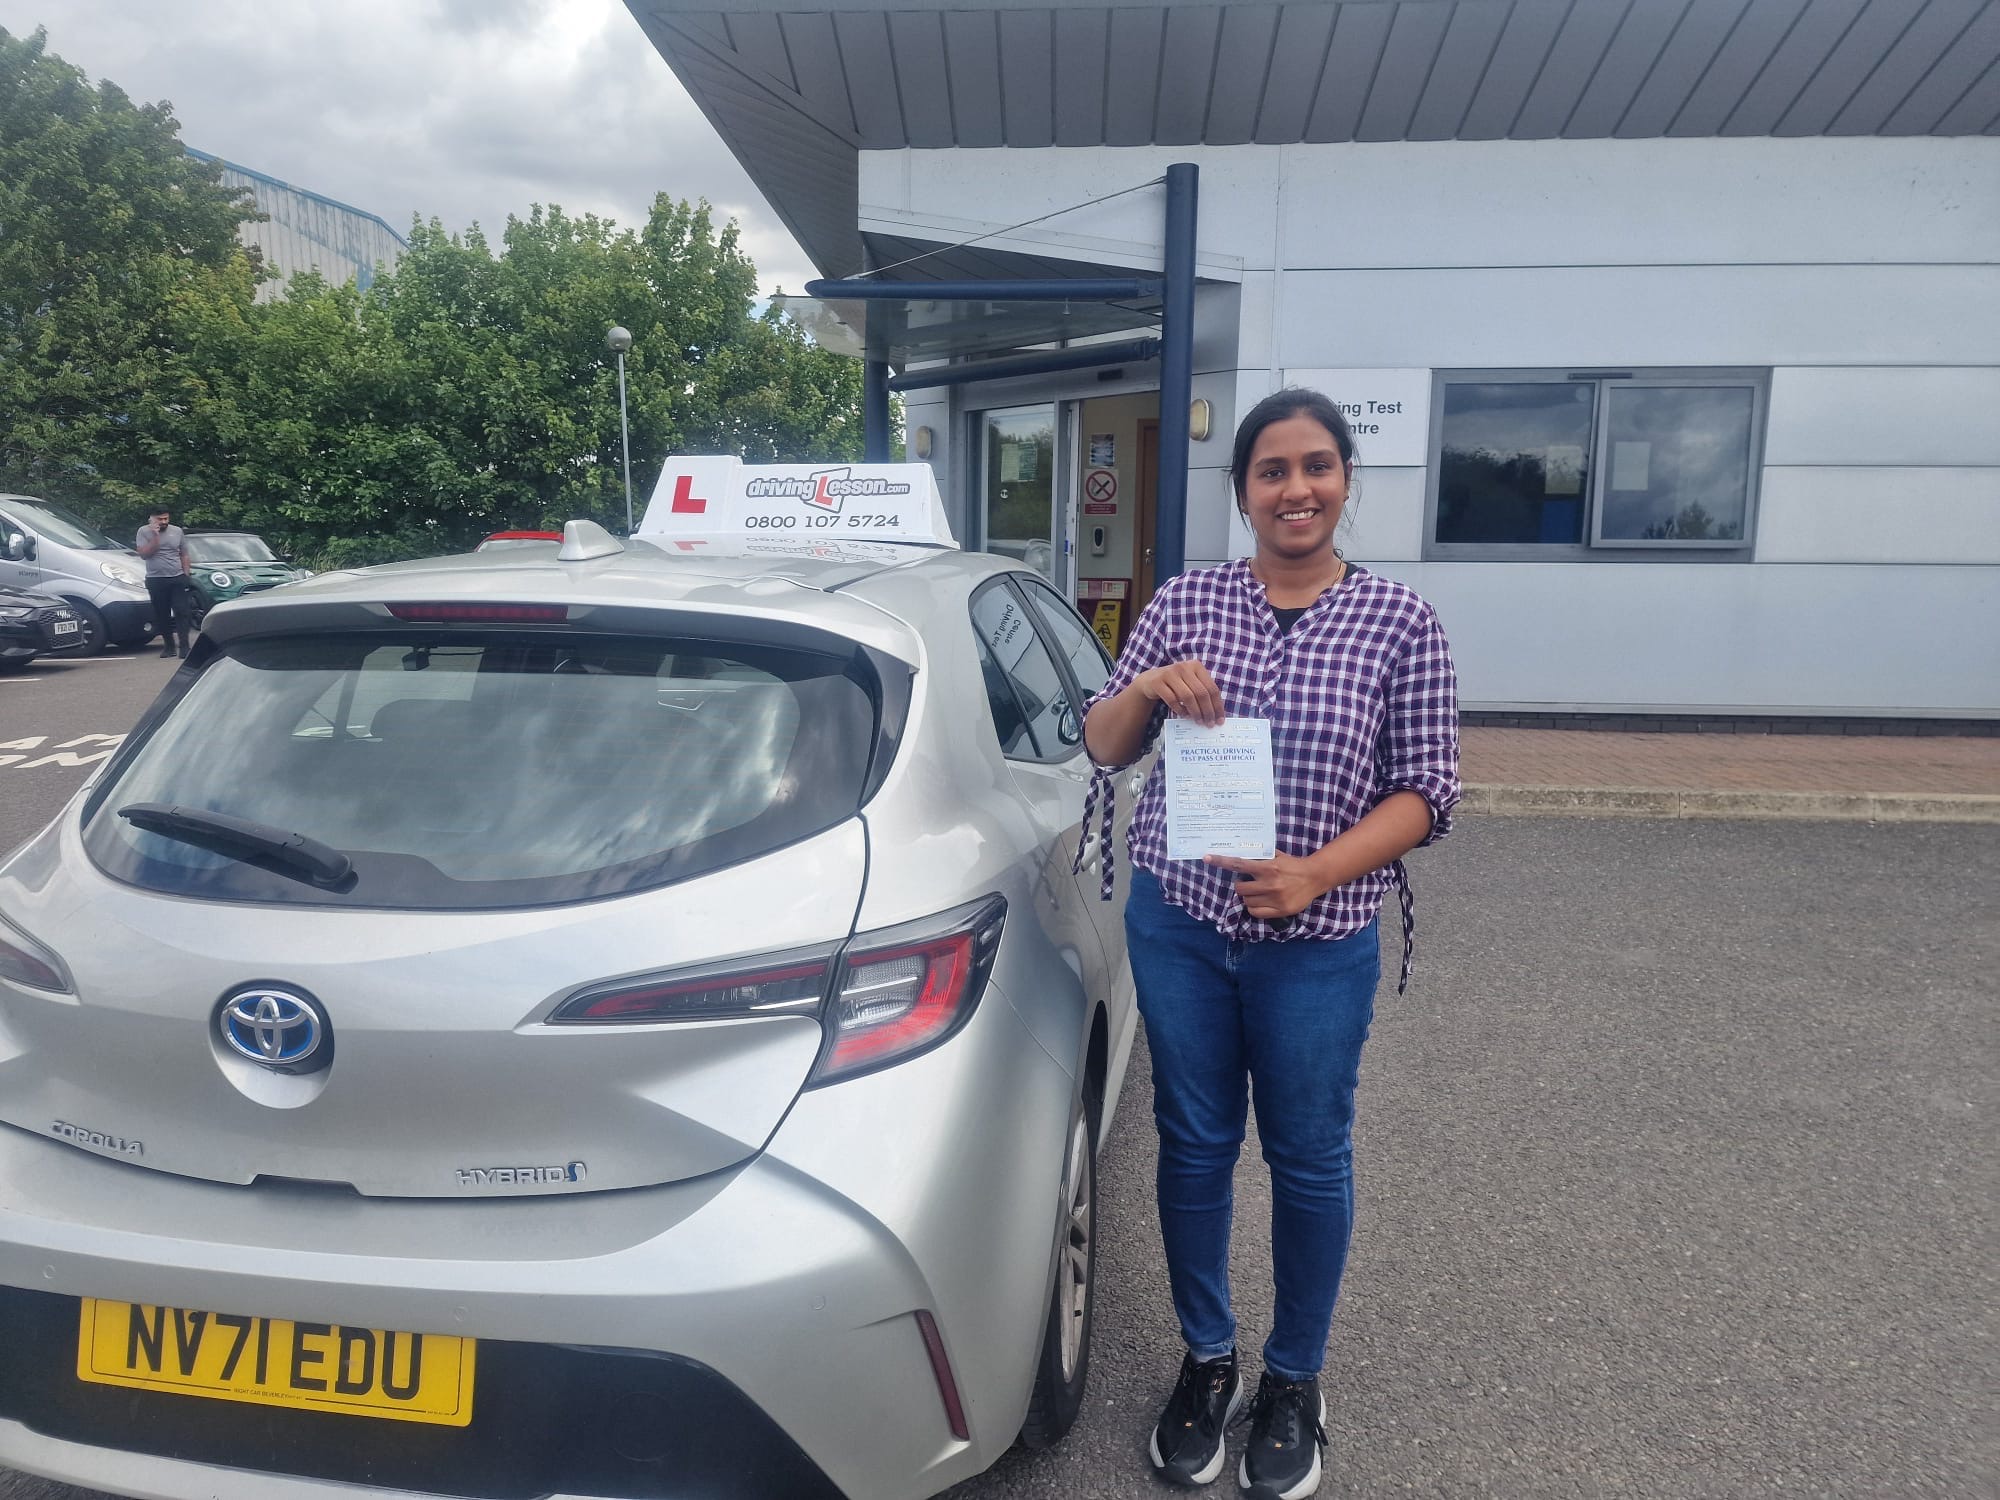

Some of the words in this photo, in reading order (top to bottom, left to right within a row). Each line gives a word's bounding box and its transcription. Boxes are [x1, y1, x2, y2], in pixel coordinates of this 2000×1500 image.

[1367, 400, 1403, 414] Test
[671, 475, 707, 513] L
[745, 516, 796, 528] 0800
[805, 516, 840, 528] 107
[847, 515, 900, 527] 5724
[49, 1119, 145, 1157] COROLLA
[456, 1165, 565, 1185] HYBRID
[126, 1302, 271, 1386] NV71
[290, 1320, 424, 1401] EDU
